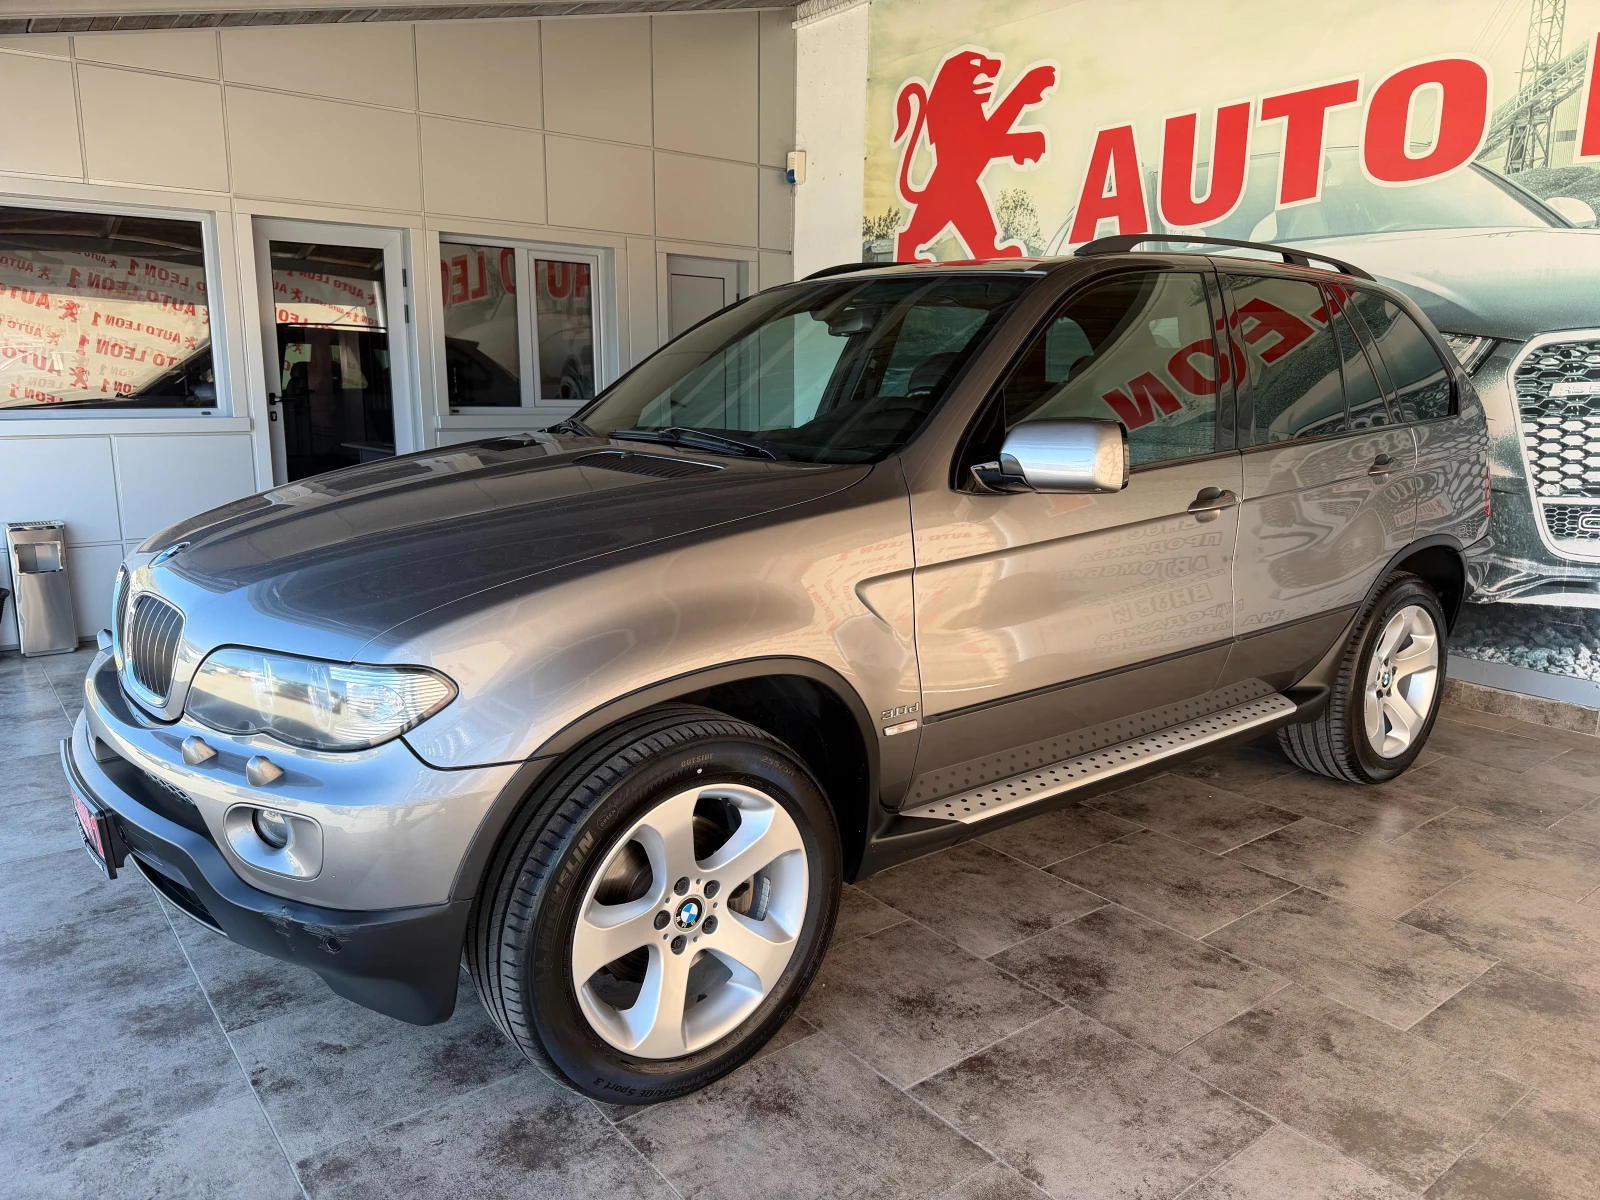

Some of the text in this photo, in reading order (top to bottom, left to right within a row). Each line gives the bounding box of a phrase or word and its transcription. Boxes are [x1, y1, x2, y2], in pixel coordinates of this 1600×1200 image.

[1068, 57, 1489, 245] AUTO
[680, 753, 716, 769] OUTSIDE
[539, 829, 595, 952] MICHELIN
[592, 1077, 605, 1087] 3
[603, 1080, 637, 1097] Sport
